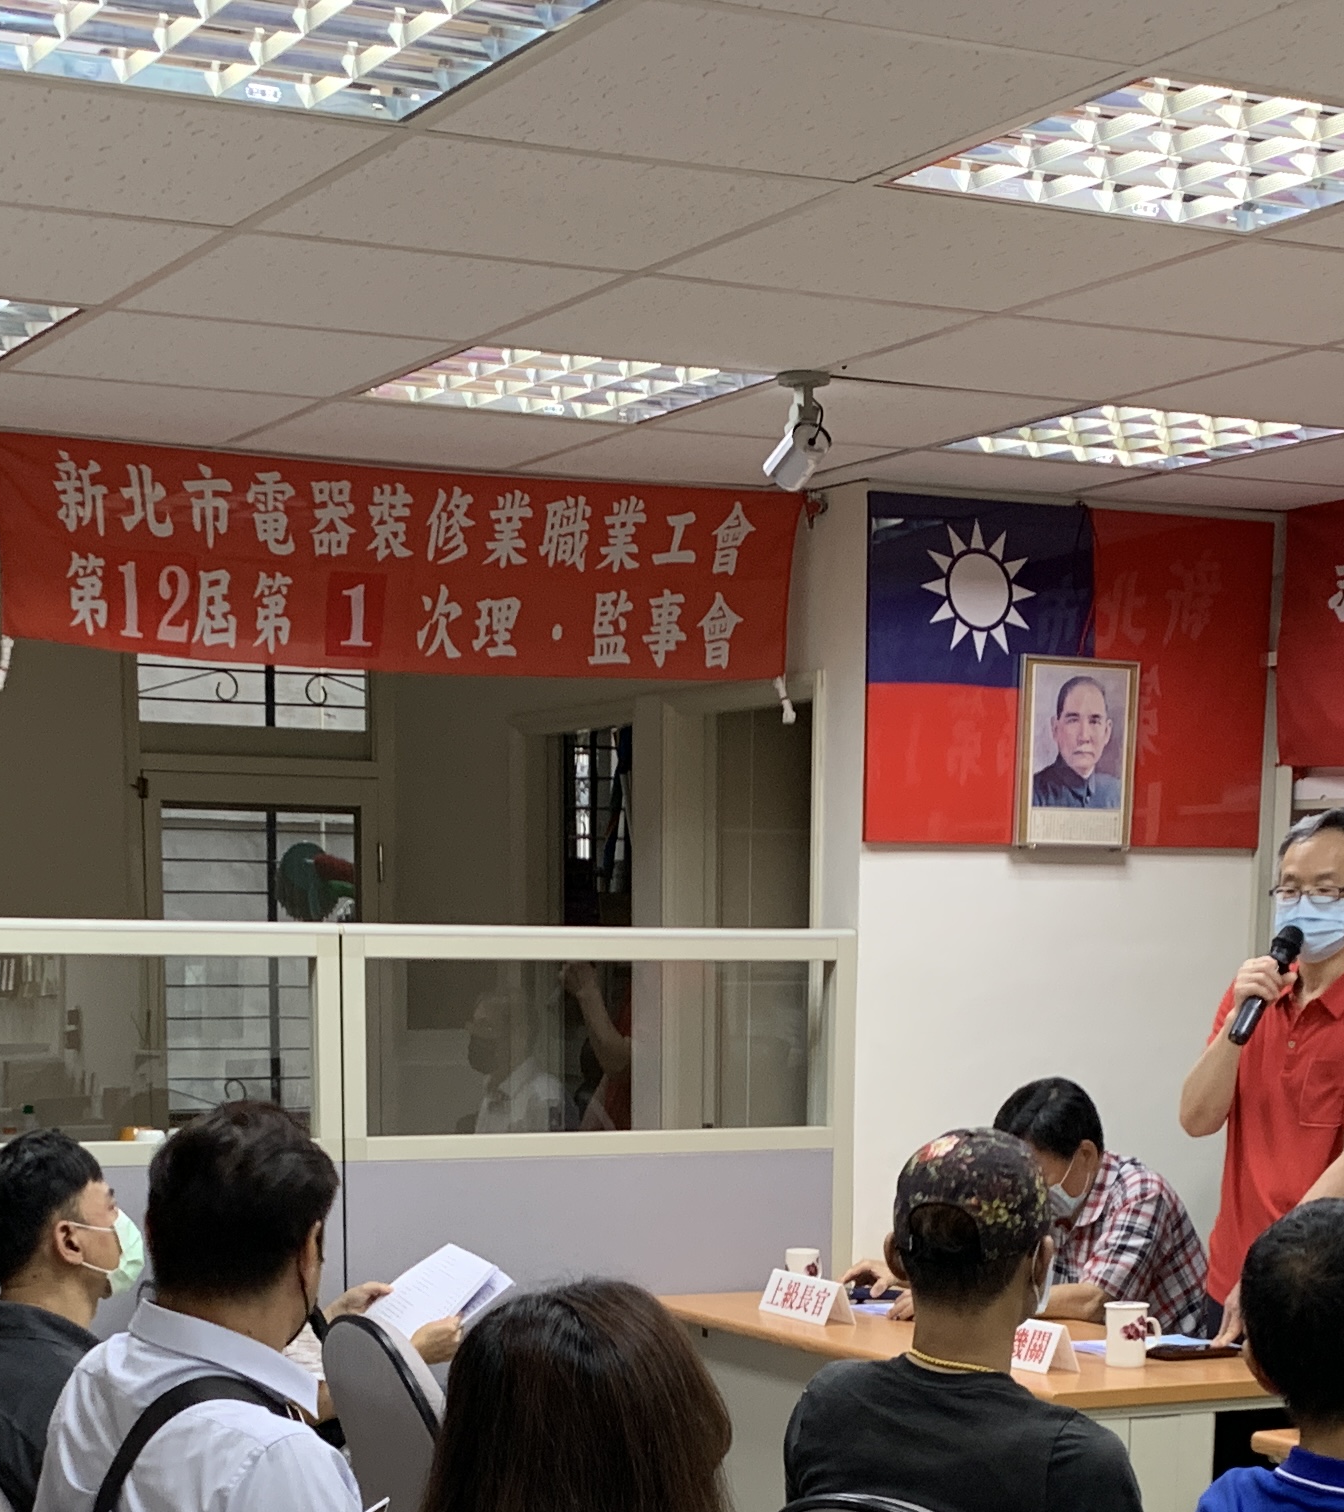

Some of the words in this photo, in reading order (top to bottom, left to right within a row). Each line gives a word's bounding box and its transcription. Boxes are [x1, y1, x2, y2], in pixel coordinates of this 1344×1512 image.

[52, 450, 757, 576] 新北市電器裝修業職業工會
[766, 1277, 831, 1317] 上級長官
